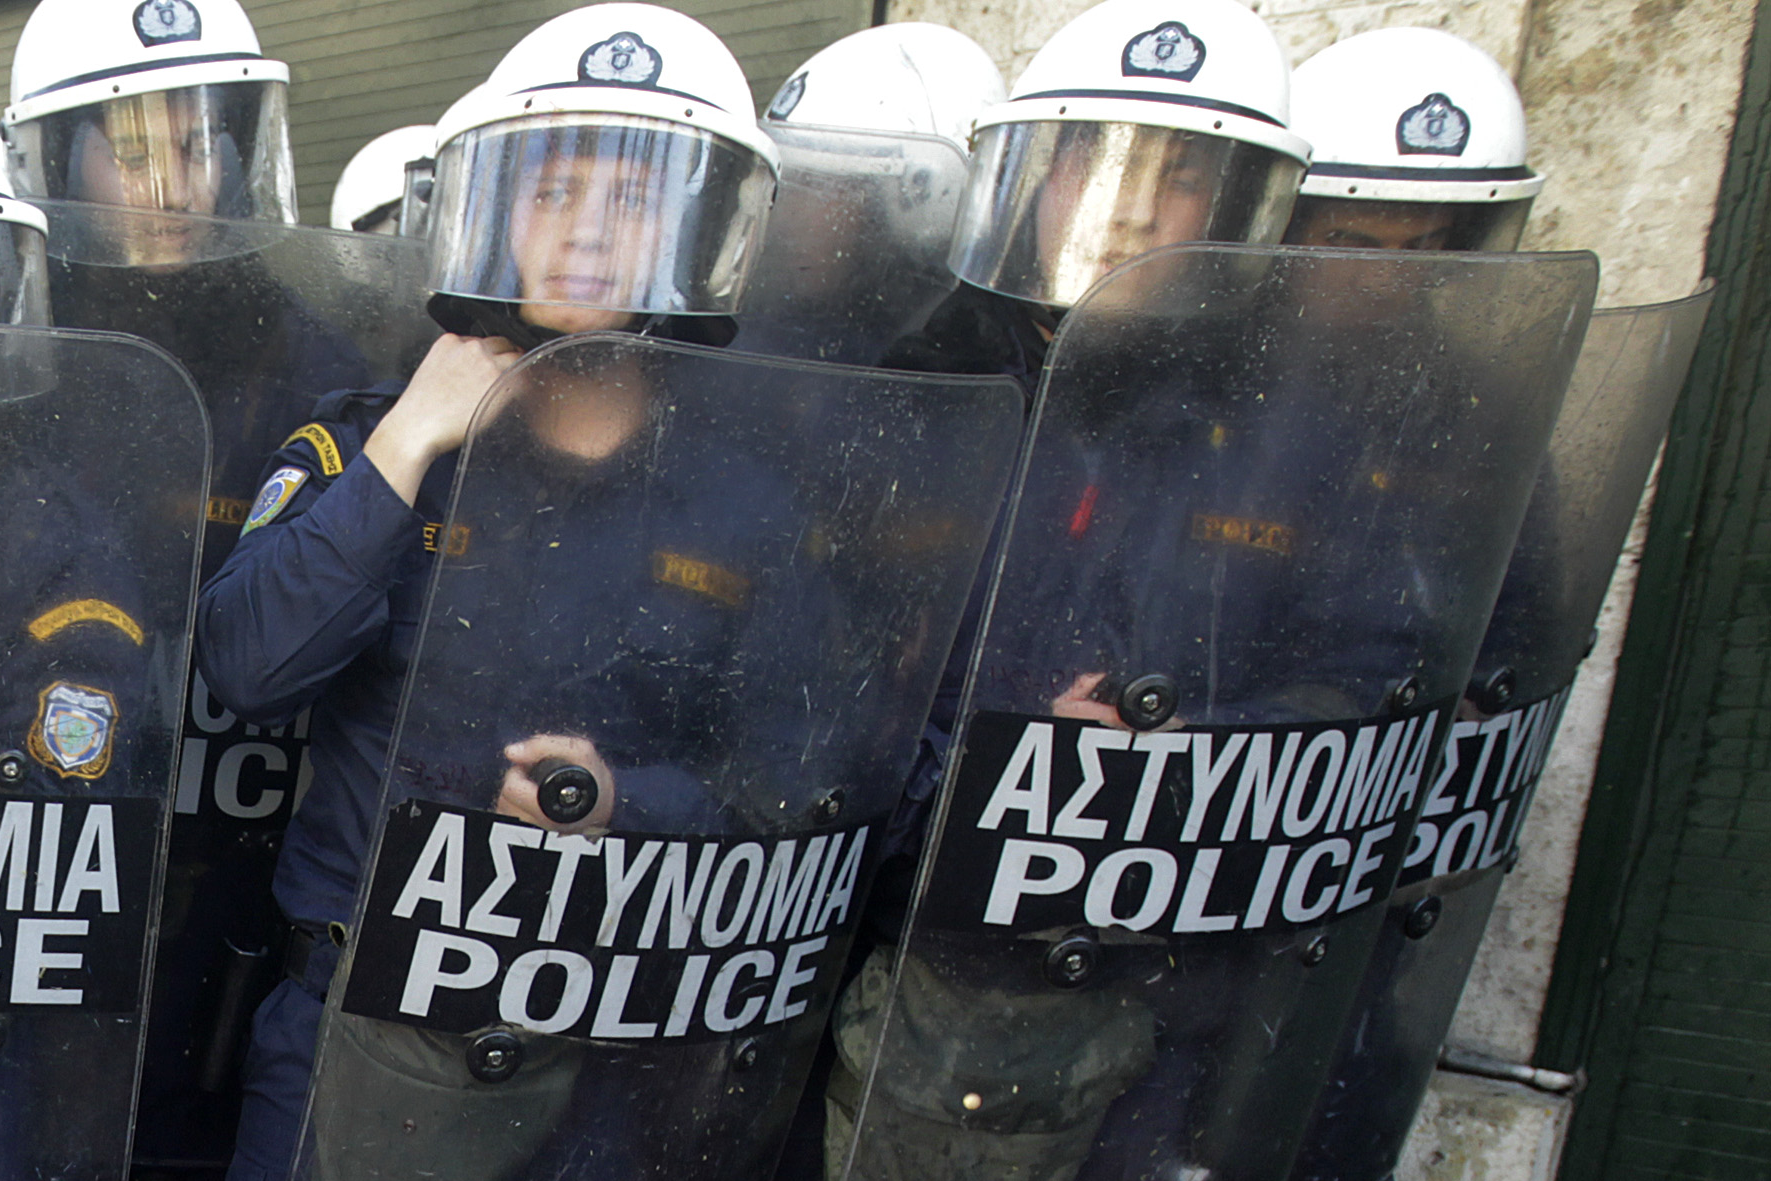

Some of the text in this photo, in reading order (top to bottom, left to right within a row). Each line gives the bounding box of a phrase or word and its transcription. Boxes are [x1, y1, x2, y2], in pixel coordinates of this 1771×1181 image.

[977, 709, 1439, 842] ΑΣΤΥΝΟΜΙΑ
[392, 811, 869, 949] ΑΣΤΥΝΟΜΙΑ
[983, 822, 1396, 933] POLICE
[398, 928, 829, 1039] POLICE
